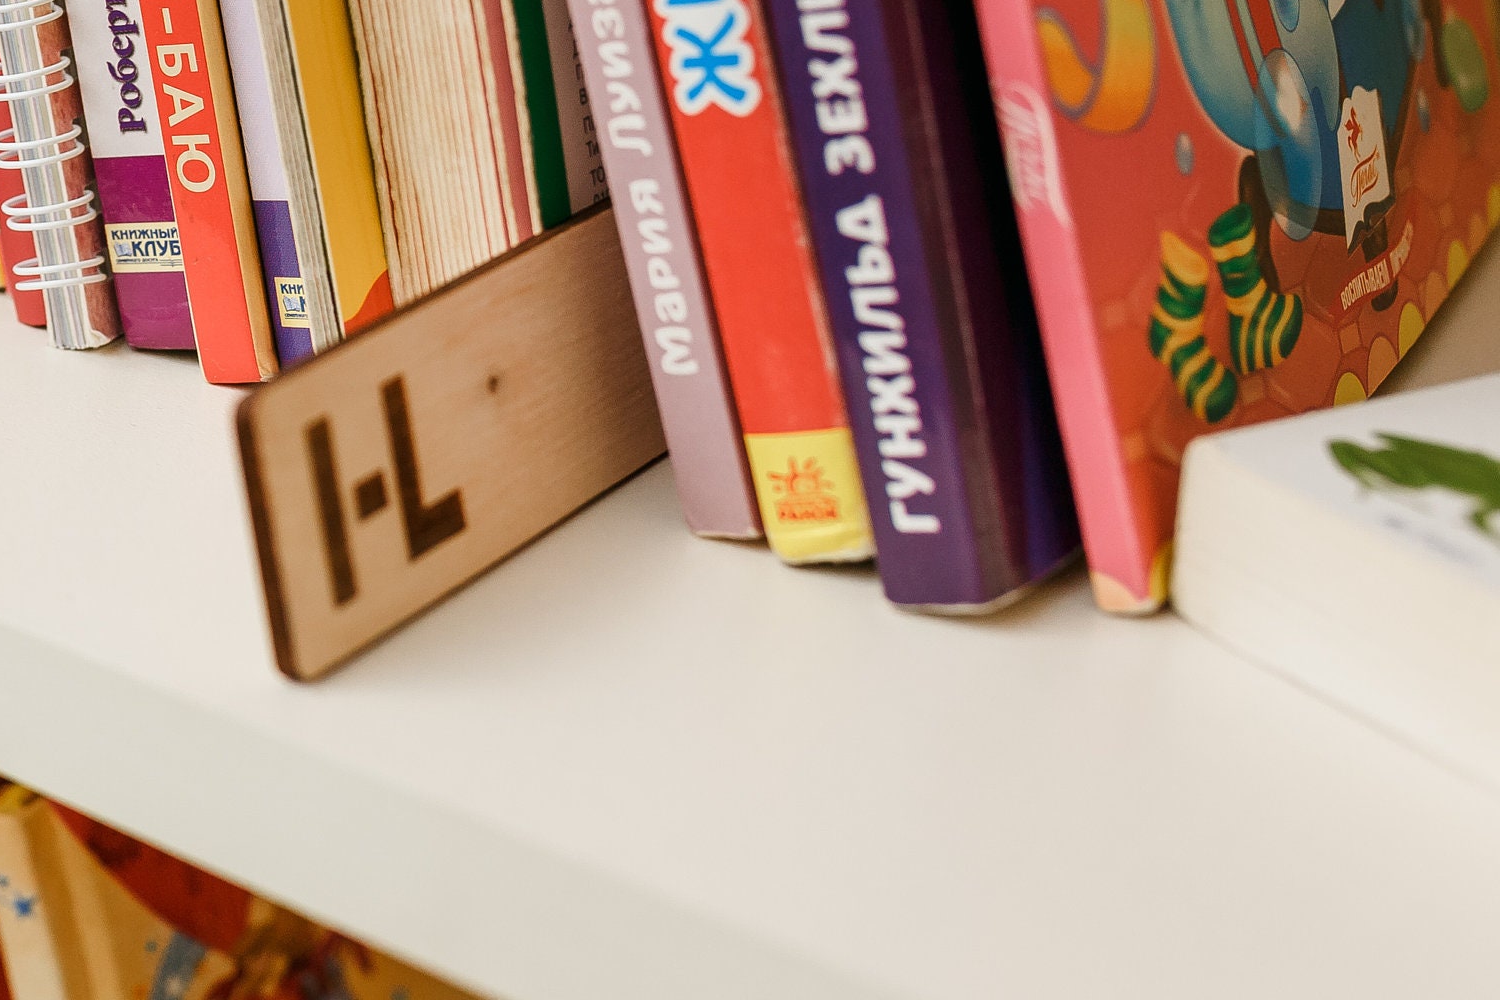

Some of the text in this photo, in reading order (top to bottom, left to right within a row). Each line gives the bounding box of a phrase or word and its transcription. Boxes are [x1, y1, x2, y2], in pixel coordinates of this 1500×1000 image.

[111, 226, 179, 240] КНИЖНЫЙ
[131, 239, 182, 257] КЛУБ
[629, 177, 701, 377] Мария
[834, 193, 942, 536] ГУНХИЛЬД
[304, 371, 467, 610] I-L
